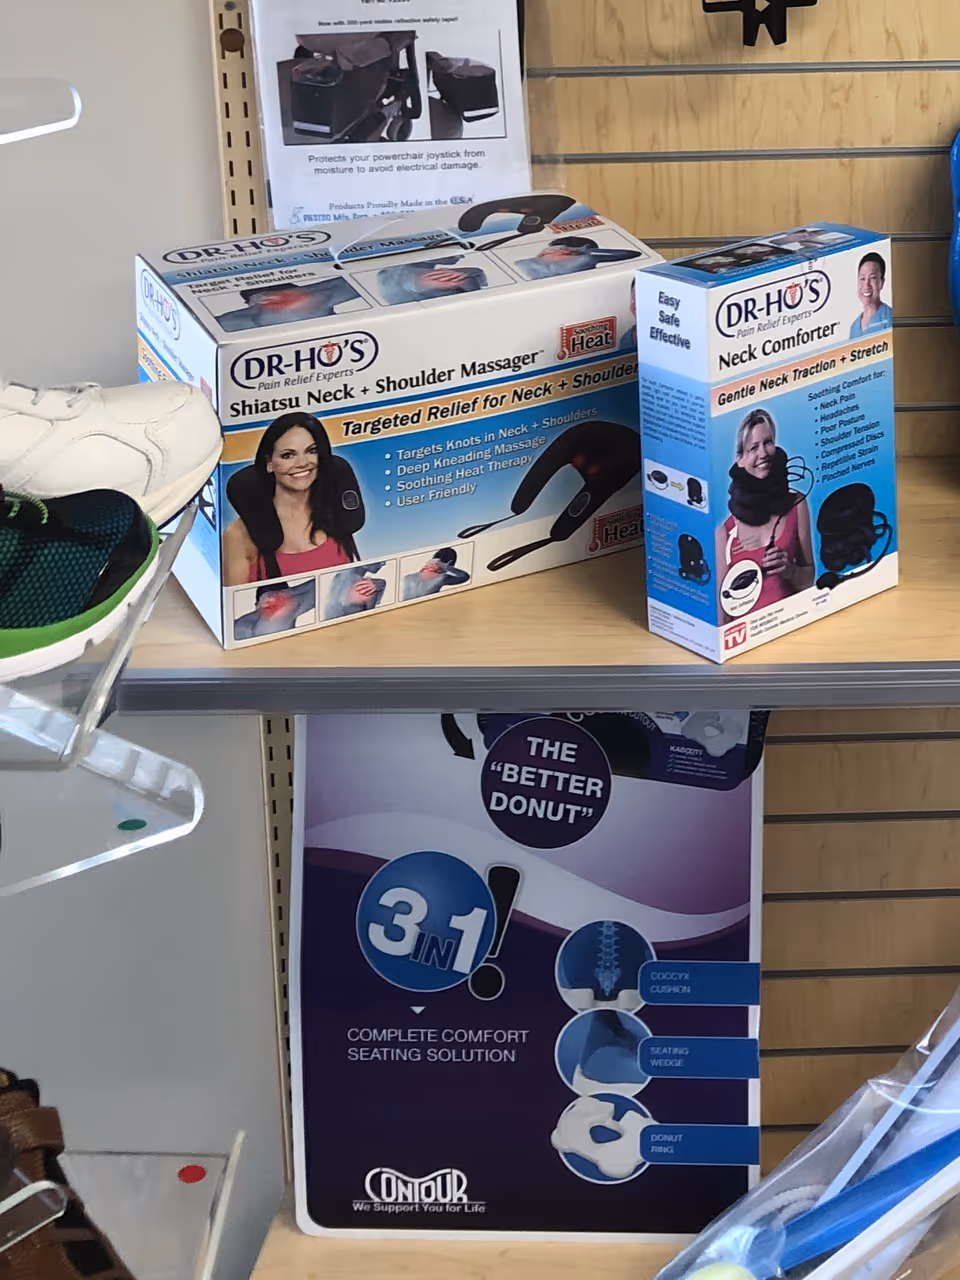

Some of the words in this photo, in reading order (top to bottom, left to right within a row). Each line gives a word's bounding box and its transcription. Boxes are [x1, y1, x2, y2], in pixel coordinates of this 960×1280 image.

[308, 154, 346, 163] Protects
[373, 152, 423, 162] powerchair
[426, 151, 460, 161] joystick
[464, 149, 485, 158] from
[314, 166, 353, 174] moisture
[369, 165, 393, 173] avoid
[397, 163, 438, 171] electrical
[177, 262, 233, 278] Shiatsu
[186, 277, 231, 291] Target
[235, 271, 274, 284] Relief
[191, 285, 228, 296] Neck
[245, 272, 316, 287] Shoulders
[658, 291, 681, 310] Easy
[727, 277, 820, 329] DR-HO'S
[573, 321, 608, 335] Soothing
[659, 311, 680, 327] Safe
[736, 323, 755, 339] Pain
[757, 316, 781, 333] Relief
[782, 309, 812, 326] Experts
[571, 330, 612, 354] Heat
[650, 326, 691, 350] Effective
[719, 344, 757, 370] Neck
[762, 322, 838, 357] Comforter
[244, 338, 366, 381] DR-HO'S
[230, 395, 301, 418] Shiatsu
[307, 386, 354, 407] Neck
[375, 367, 455, 394] Shoulder
[460, 351, 539, 380] Massager
[257, 380, 281, 392] Pain
[284, 374, 314, 387] Relief
[316, 368, 354, 384] Experts
[718, 385, 755, 406] Gentle
[759, 373, 788, 393] Neck
[793, 359, 836, 381] Traction
[850, 341, 889, 362] Stretch
[808, 384, 840, 401] Soothing
[842, 374, 871, 390] Comfort
[343, 408, 421, 437] Targeted
[427, 397, 478, 421] Relief
[482, 391, 506, 409] for
[509, 381, 552, 404] Neck
[820, 398, 838, 410] Neck
[840, 392, 856, 403] Pain
[820, 403, 860, 422] Headaches
[397, 442, 442, 461] Targets
[446, 436, 480, 452] Knots
[484, 433, 495, 445] in
[499, 424, 529, 440] Neck
[542, 406, 598, 428] Shoulders
[820, 423, 837, 434] Poor
[839, 414, 866, 428] Posture
[820, 430, 852, 446] Shoulder
[854, 420, 880, 435] Tension
[397, 460, 429, 477] Deep
[434, 449, 492, 471] Kneading
[494, 435, 546, 456] Massage
[821, 437, 865, 459] Compressed
[866, 431, 885, 442] Discs
[821, 453, 856, 471] Repetitive
[858, 445, 879, 457] Strain
[397, 474, 452, 495] Soothing
[455, 466, 485, 481] Heat
[488, 454, 533, 475] Therapy
[822, 468, 850, 483] Pinched
[851, 458, 876, 471] Nerves
[397, 493, 425, 507] User
[428, 482, 477, 503] Friendly
[725, 628, 746, 648] TV
[527, 736, 578, 763] THE
[650, 970, 690, 981] COCCYX
[650, 984, 691, 994] CUSHION
[347, 1028, 437, 1043] COMPLETE
[442, 1028, 529, 1044] COMFORT
[347, 1047, 421, 1062] SEATING
[426, 1048, 515, 1063] SOLUTION
[650, 1046, 689, 1056] SEATING
[650, 1058, 684, 1067] WEDGE
[650, 1134, 683, 1143] DONUT
[650, 1145, 674, 1154] RING
[365, 1167, 468, 1202] CONTOUR
[353, 1202, 371, 1212] We
[374, 1202, 419, 1214] Support
[422, 1202, 442, 1213] You
[446, 1202, 461, 1212] for
[465, 1202, 486, 1213] Life
